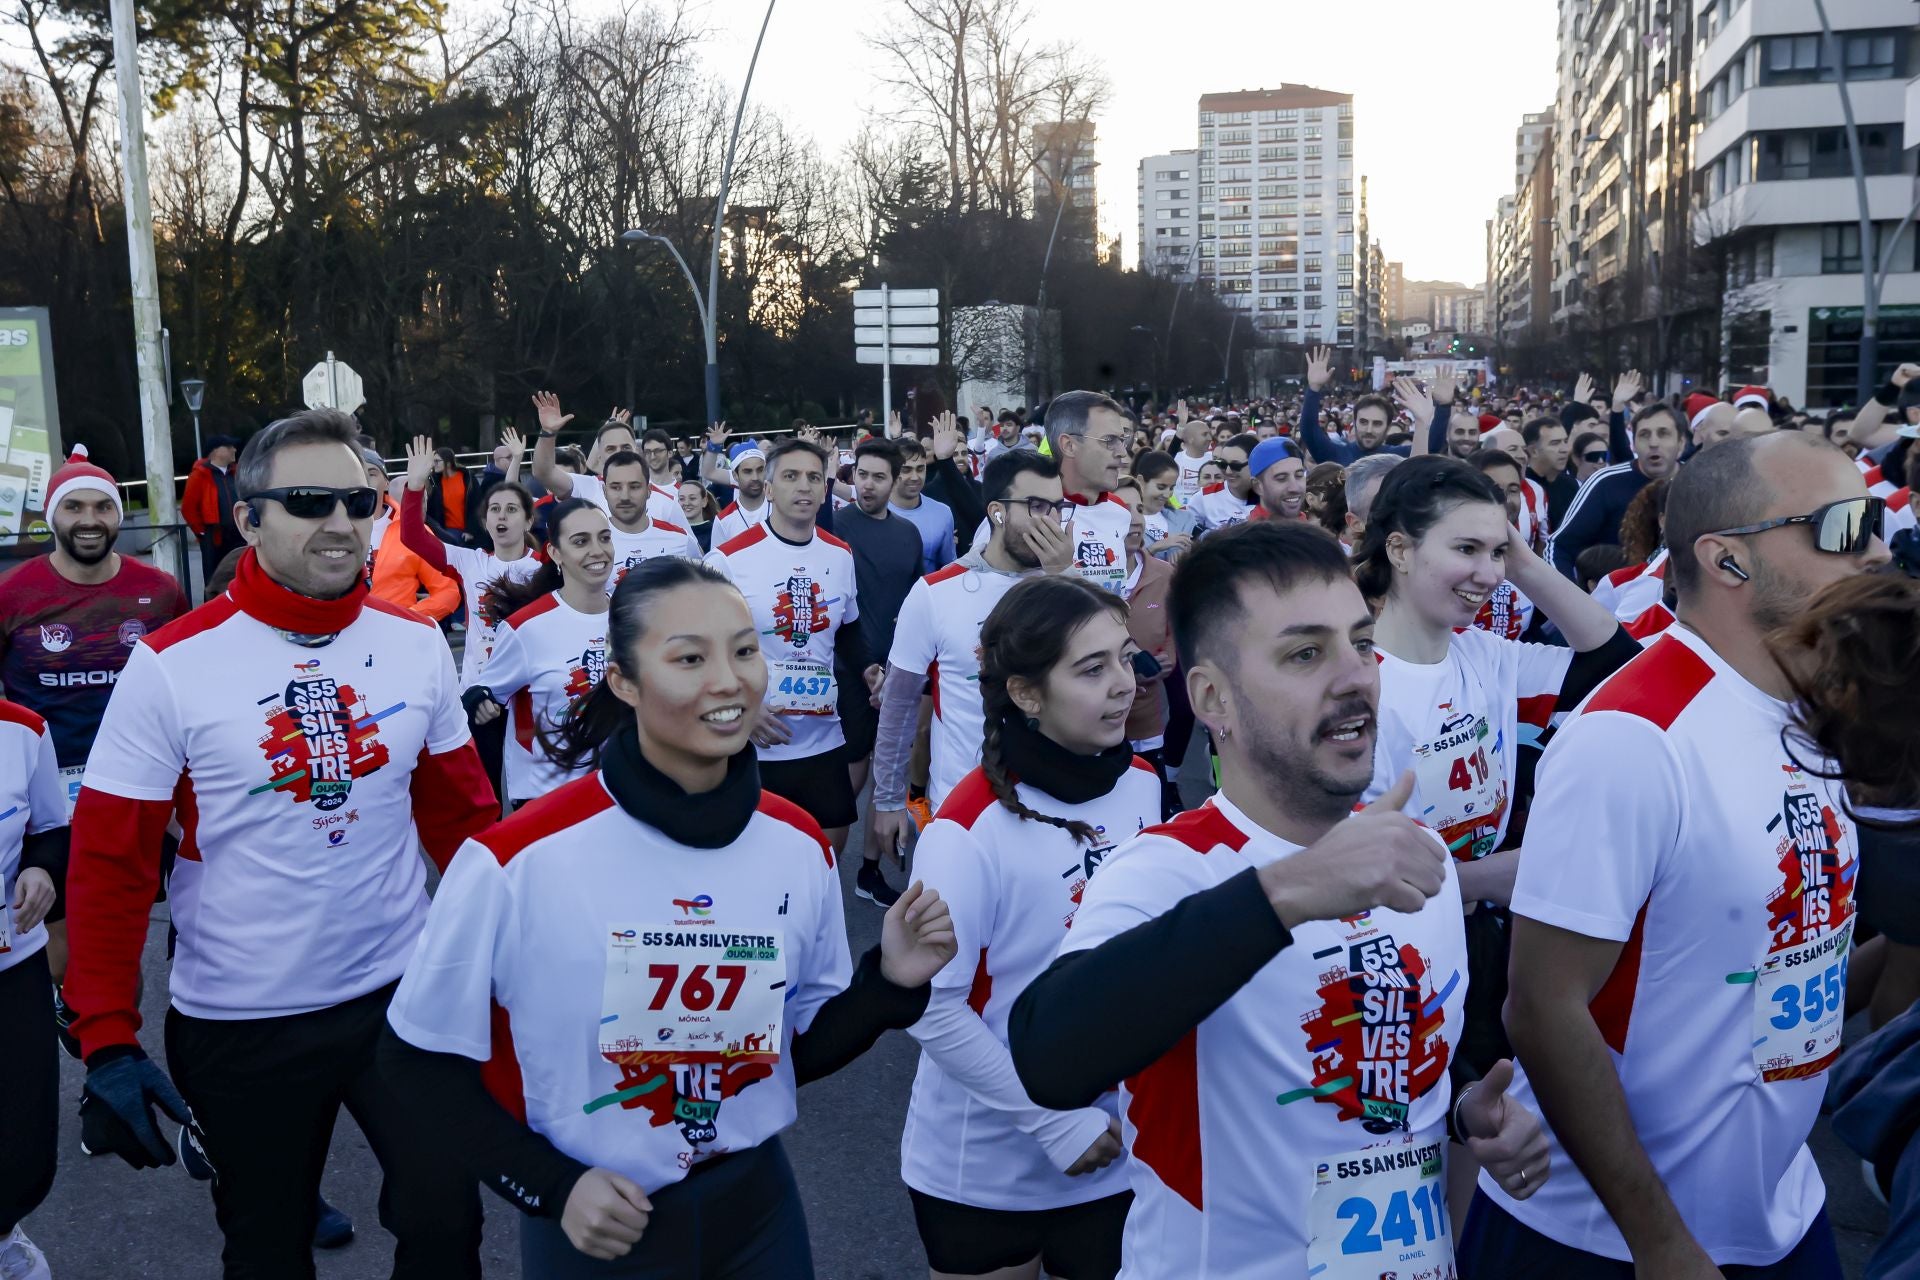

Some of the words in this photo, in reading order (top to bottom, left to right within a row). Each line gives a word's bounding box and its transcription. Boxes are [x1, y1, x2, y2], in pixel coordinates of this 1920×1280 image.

[1083, 553, 1106, 566] SAN
[1091, 544, 1105, 555] 55
[791, 585, 811, 597] SAN
[798, 579, 811, 588] 55
[1499, 585, 1511, 595] 55
[793, 596, 811, 608] SIL
[1491, 592, 1510, 604] SAN
[793, 608, 812, 620] VES
[1493, 603, 1509, 615] SIL
[792, 620, 811, 633] TRE
[1492, 616, 1509, 627] VES
[307, 680, 337, 699] 55
[779, 677, 830, 695] 4637
[294, 695, 340, 714] SAN
[301, 712, 343, 735] SIL
[306, 732, 349, 757] VES
[1434, 740, 1449, 752] 55
[1449, 731, 1470, 747] SAN
[307, 754, 352, 781] TRE
[1448, 746, 1488, 791] 418
[322, 798, 342, 807] 2024
[1798, 796, 1823, 826] 55
[1792, 819, 1828, 853] SAN
[1800, 853, 1829, 890] SIL
[1803, 887, 1831, 928] VES
[642, 932, 663, 946] 55
[665, 932, 697, 947] SAN
[699, 933, 775, 949] SILVESTRE
[1361, 937, 1399, 970] 55
[1785, 952, 1802, 968] 55
[1803, 943, 1822, 963] SAN
[1362, 959, 1411, 989] SAN
[648, 964, 746, 1011] 767
[1363, 988, 1410, 1024] SIL
[678, 1014, 711, 1023] MÓNICA
[1361, 1023, 1411, 1058] VES
[669, 1063, 723, 1102] TRE
[1357, 1059, 1410, 1104] TRE
[1337, 1160, 1360, 1179] 55
[1361, 1154, 1396, 1175] SAN
[1336, 1181, 1446, 1256] 2411
[1399, 1250, 1426, 1261] DANIEL
